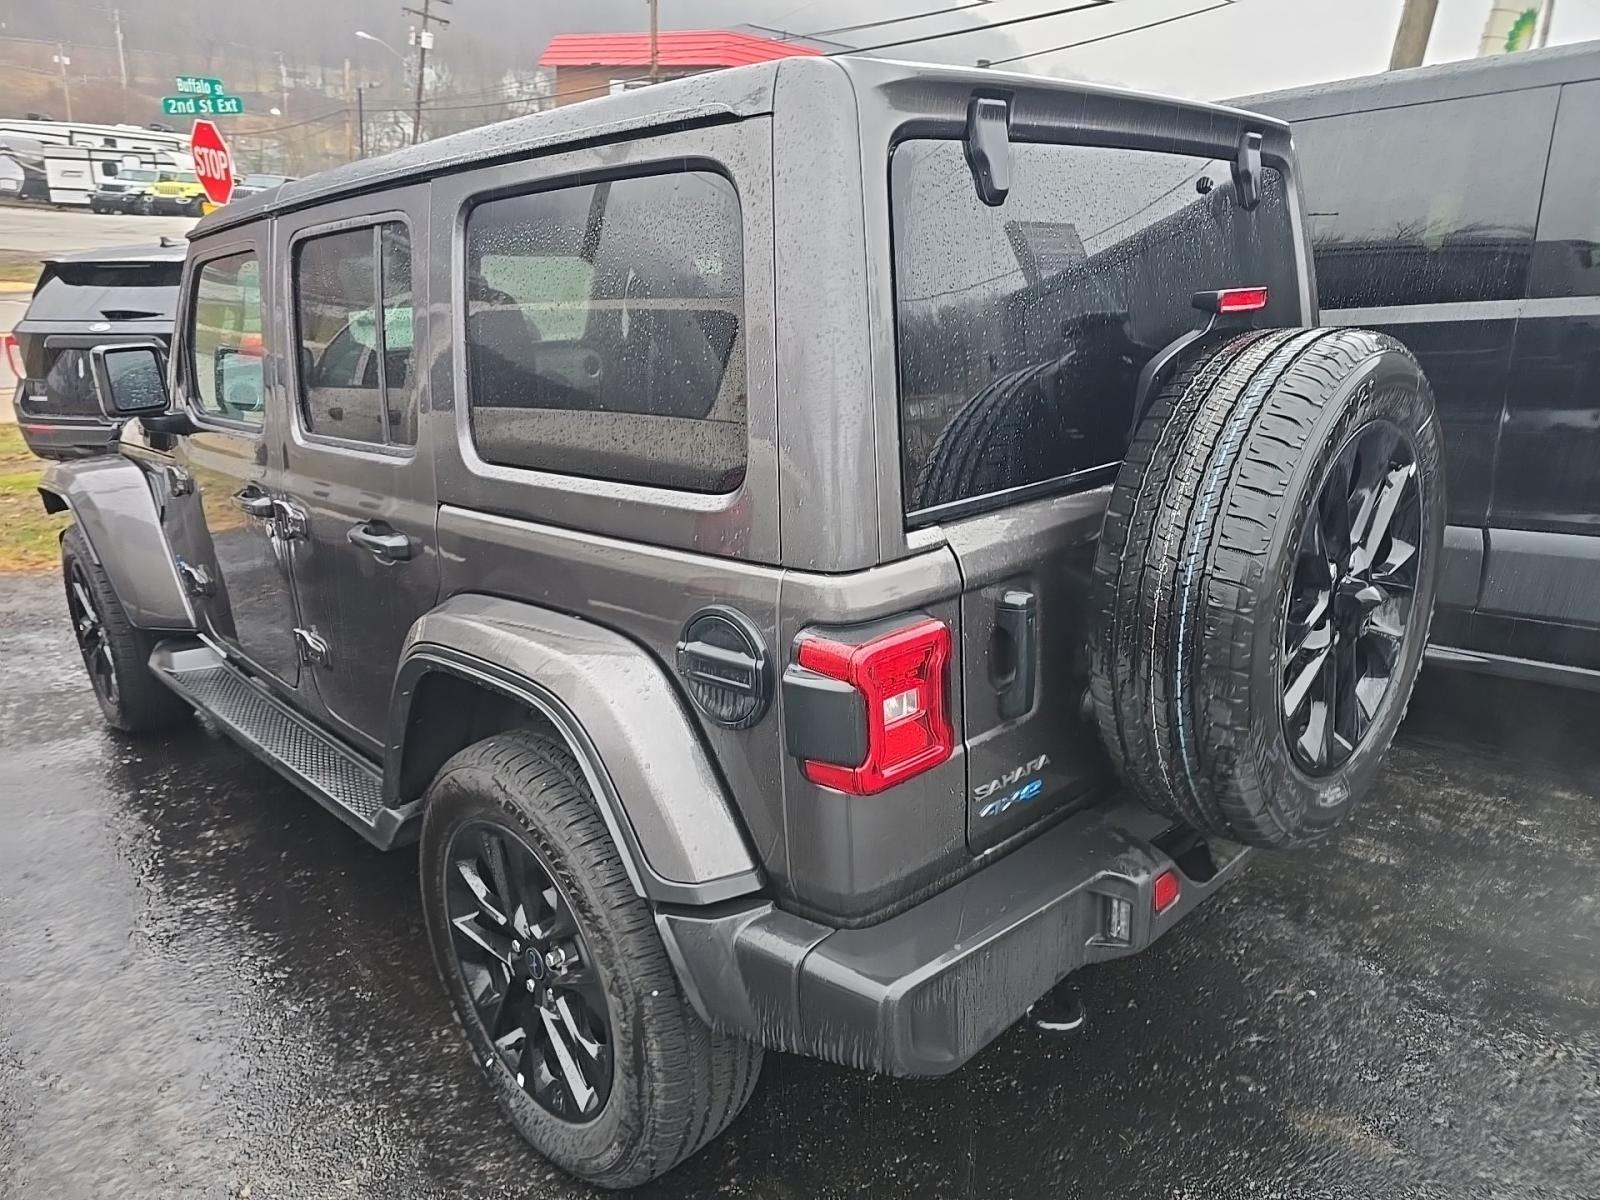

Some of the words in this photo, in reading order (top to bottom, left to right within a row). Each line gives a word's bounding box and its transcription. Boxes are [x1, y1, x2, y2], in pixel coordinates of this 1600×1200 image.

[176, 78, 211, 94] Buffalo
[168, 99, 196, 113] 2nd
[198, 99, 214, 113] St
[216, 98, 239, 112] Ext
[193, 145, 228, 181] STOP
[973, 753, 1050, 802] SAHARA
